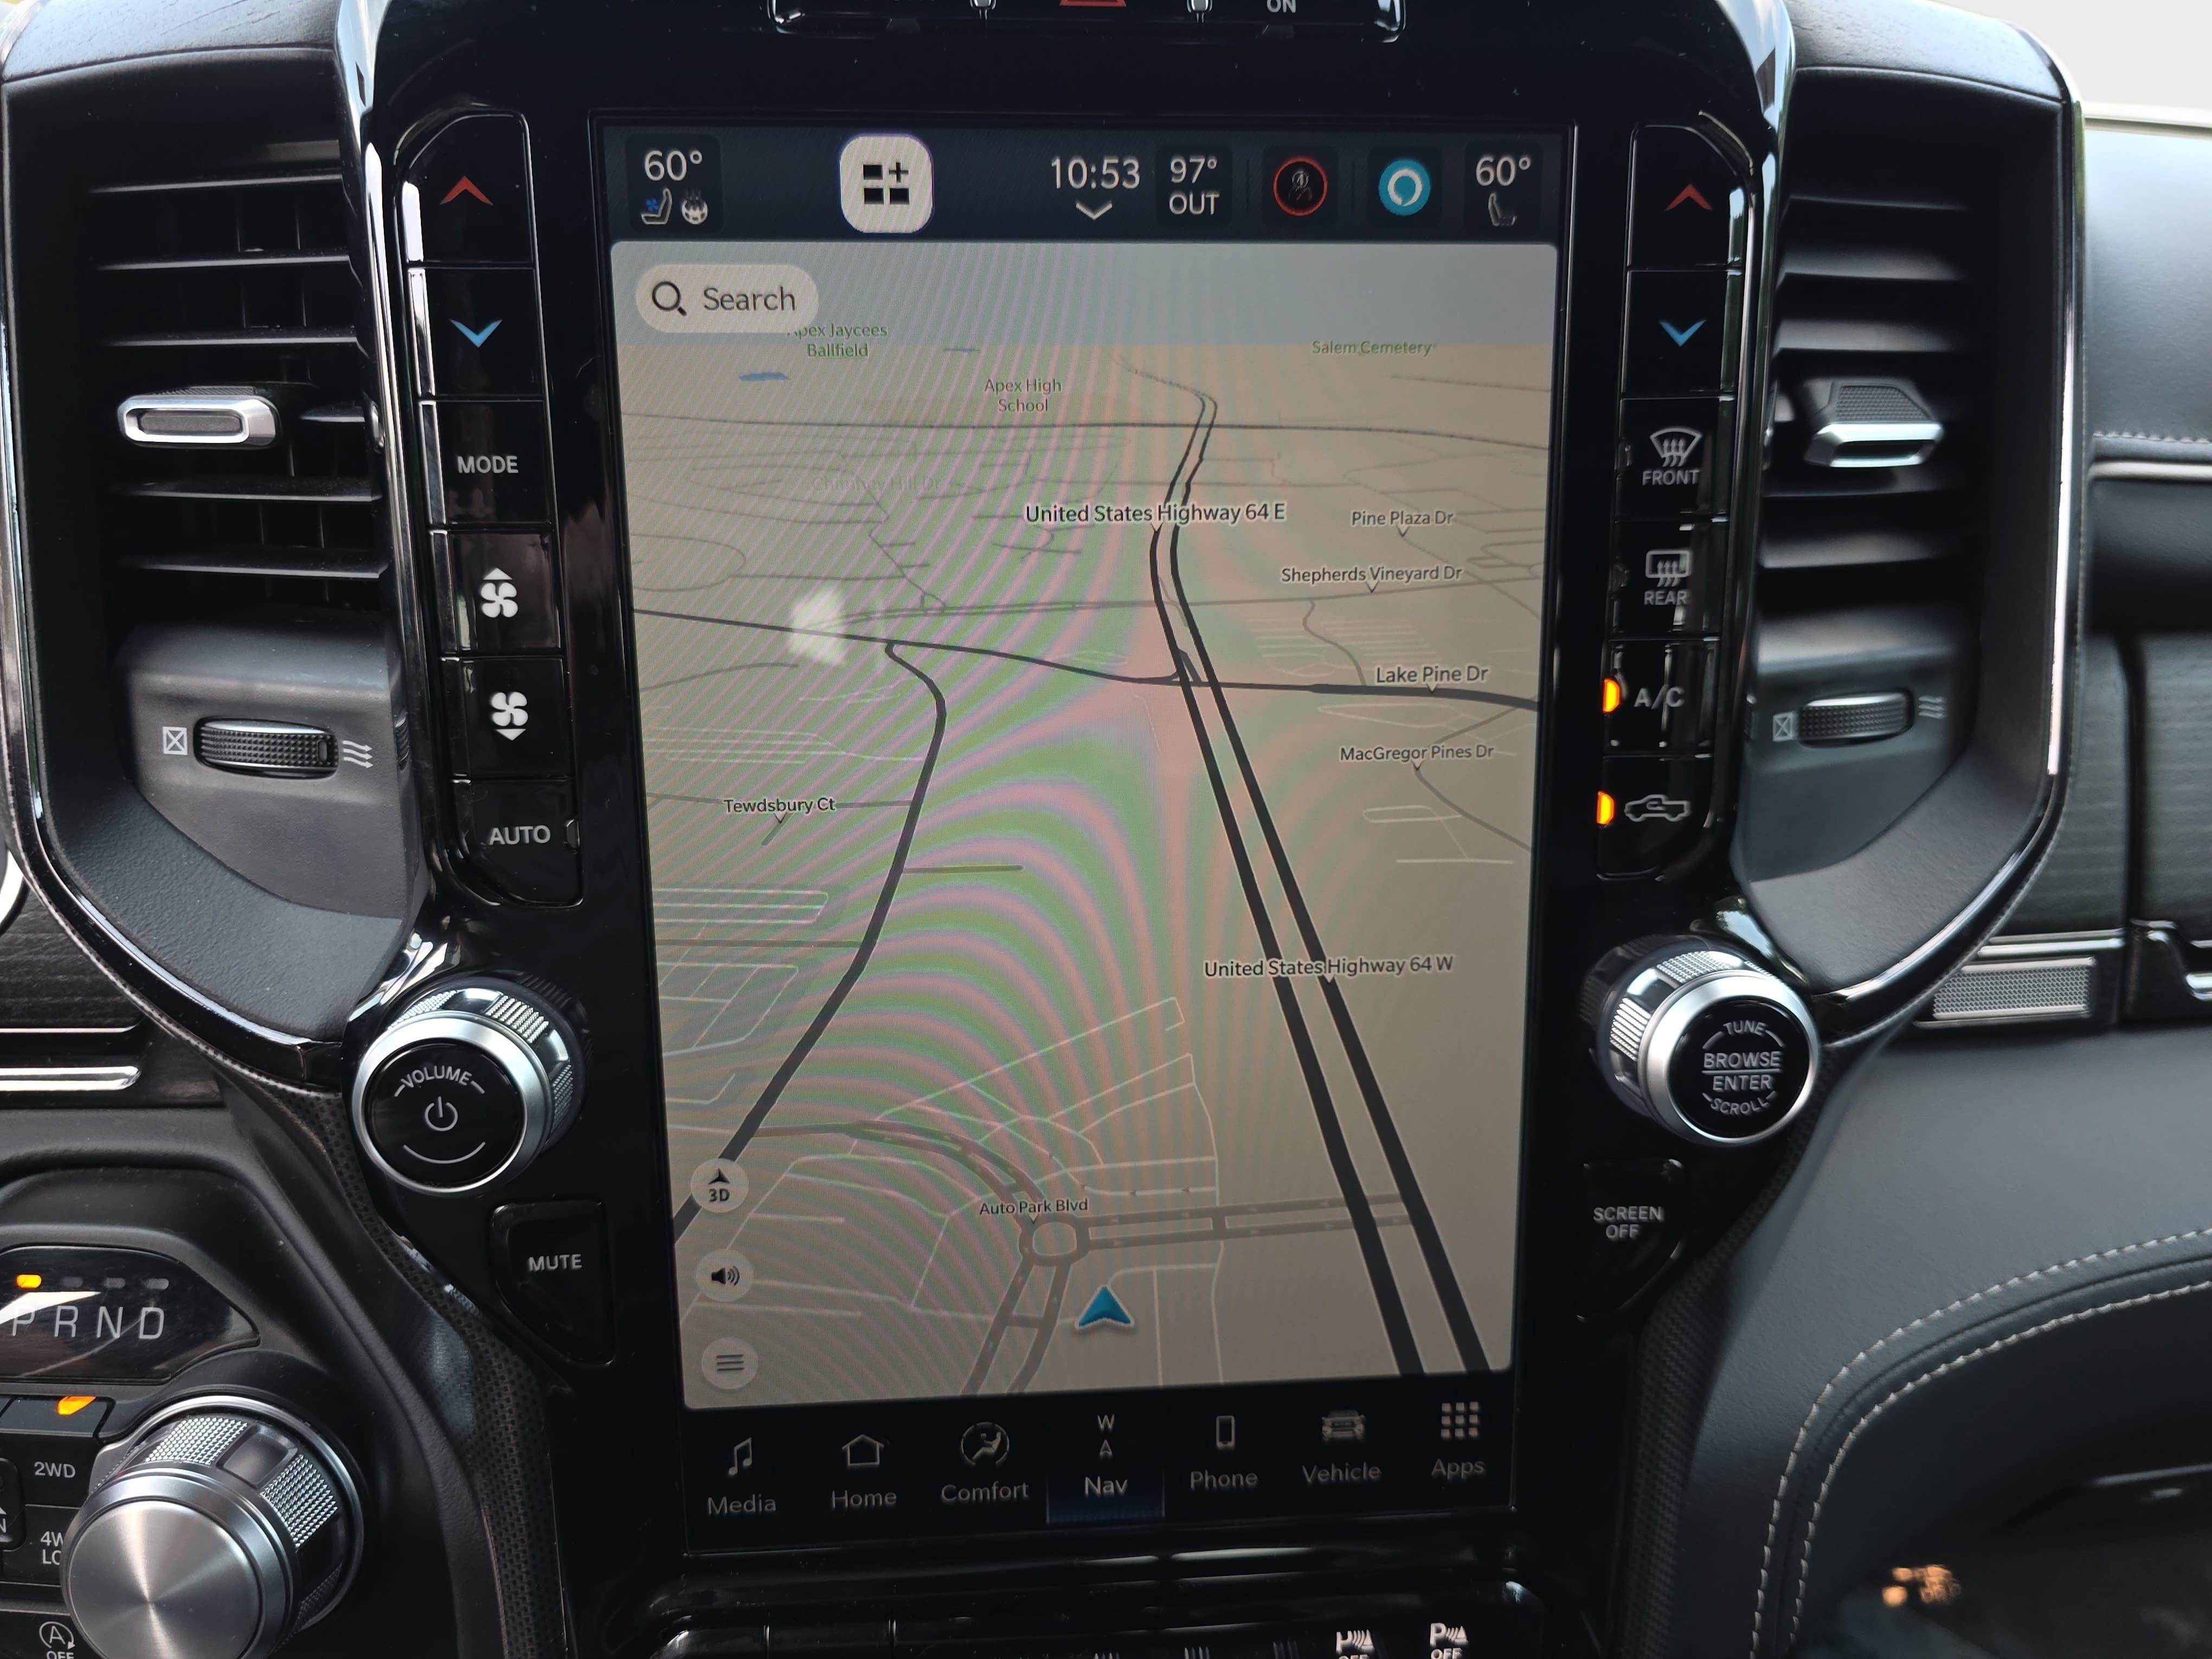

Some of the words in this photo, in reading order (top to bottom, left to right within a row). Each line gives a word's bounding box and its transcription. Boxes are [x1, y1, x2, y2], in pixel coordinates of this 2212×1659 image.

[1266, 0, 1296, 13] ON
[1051, 156, 1141, 190] 10:53
[1169, 193, 1220, 216] OUT
[703, 286, 796, 312] Search
[787, 325, 826, 340] pex
[829, 323, 888, 340] Jaycees
[807, 343, 869, 358] Ballfield
[1311, 340, 1359, 356] Salem
[1360, 339, 1432, 358] Cemetery
[984, 378, 1023, 397] Apex
[1026, 378, 1063, 396] High
[998, 398, 1049, 413] School
[457, 455, 519, 474] MODE
[1642, 467, 1700, 487] FRONT
[1026, 505, 1089, 523] United
[1094, 504, 1153, 522] States
[1158, 504, 1241, 526] Highway
[1245, 504, 1269, 520] 64
[1274, 503, 1286, 520] E
[1352, 511, 1386, 525] Pine
[1391, 511, 1431, 525] Plaza
[1435, 511, 1454, 525] Dr
[1281, 567, 1366, 584] Shepherds
[1369, 566, 1439, 583] Vineyard
[1444, 565, 1463, 580] Dr
[1644, 589, 1688, 607] REAR
[1376, 667, 1418, 684] Lake
[1423, 666, 1461, 682] Pine
[1467, 666, 1489, 681] Dr
[1634, 685, 1685, 710] A/C
[1340, 747, 1427, 762] MacGregor
[1431, 745, 1472, 759] Pines
[1476, 744, 1494, 758] Dr
[724, 798, 813, 814] Tewdsbury
[817, 797, 835, 811] Ct
[488, 825, 551, 846] AUTO
[1205, 961, 1264, 977] United
[1268, 960, 1323, 976] States
[1328, 957, 1406, 976] Highway
[1410, 956, 1432, 972] 64
[1436, 955, 1454, 971] W
[1723, 1020, 1767, 1037] TUNE
[1703, 1051, 1783, 1070] BROWSE
[401, 1065, 473, 1089] VOLUME
[1712, 1074, 1774, 1092] ENTER
[1709, 1097, 1771, 1115] SCROLL
[709, 1188, 730, 1203] 3D
[979, 1200, 1015, 1215] Auto
[1019, 1199, 1052, 1213] Park
[1056, 1198, 1089, 1212] Blvd
[1593, 1205, 1666, 1223] SCREEN
[1605, 1224, 1641, 1242] OFF
[529, 1253, 583, 1272] MUTE
[12, 1306, 36, 1336] P
[54, 1306, 79, 1338] R
[96, 1307, 123, 1340] N
[138, 1306, 165, 1340] D
[1097, 1414, 1115, 1432] W
[34, 1461, 76, 1480] 2WD
[1302, 1462, 1382, 1484] Vehicle
[1431, 1458, 1486, 1480] Apps
[1084, 1476, 1128, 1495] Nav
[1190, 1470, 1259, 1490] Phone
[831, 1489, 897, 1510] Home
[941, 1481, 1029, 1504] Comfort
[708, 1494, 777, 1515] Media
[40, 1531, 64, 1547] 4W
[1431, 1648, 1463, 1659] OFF
